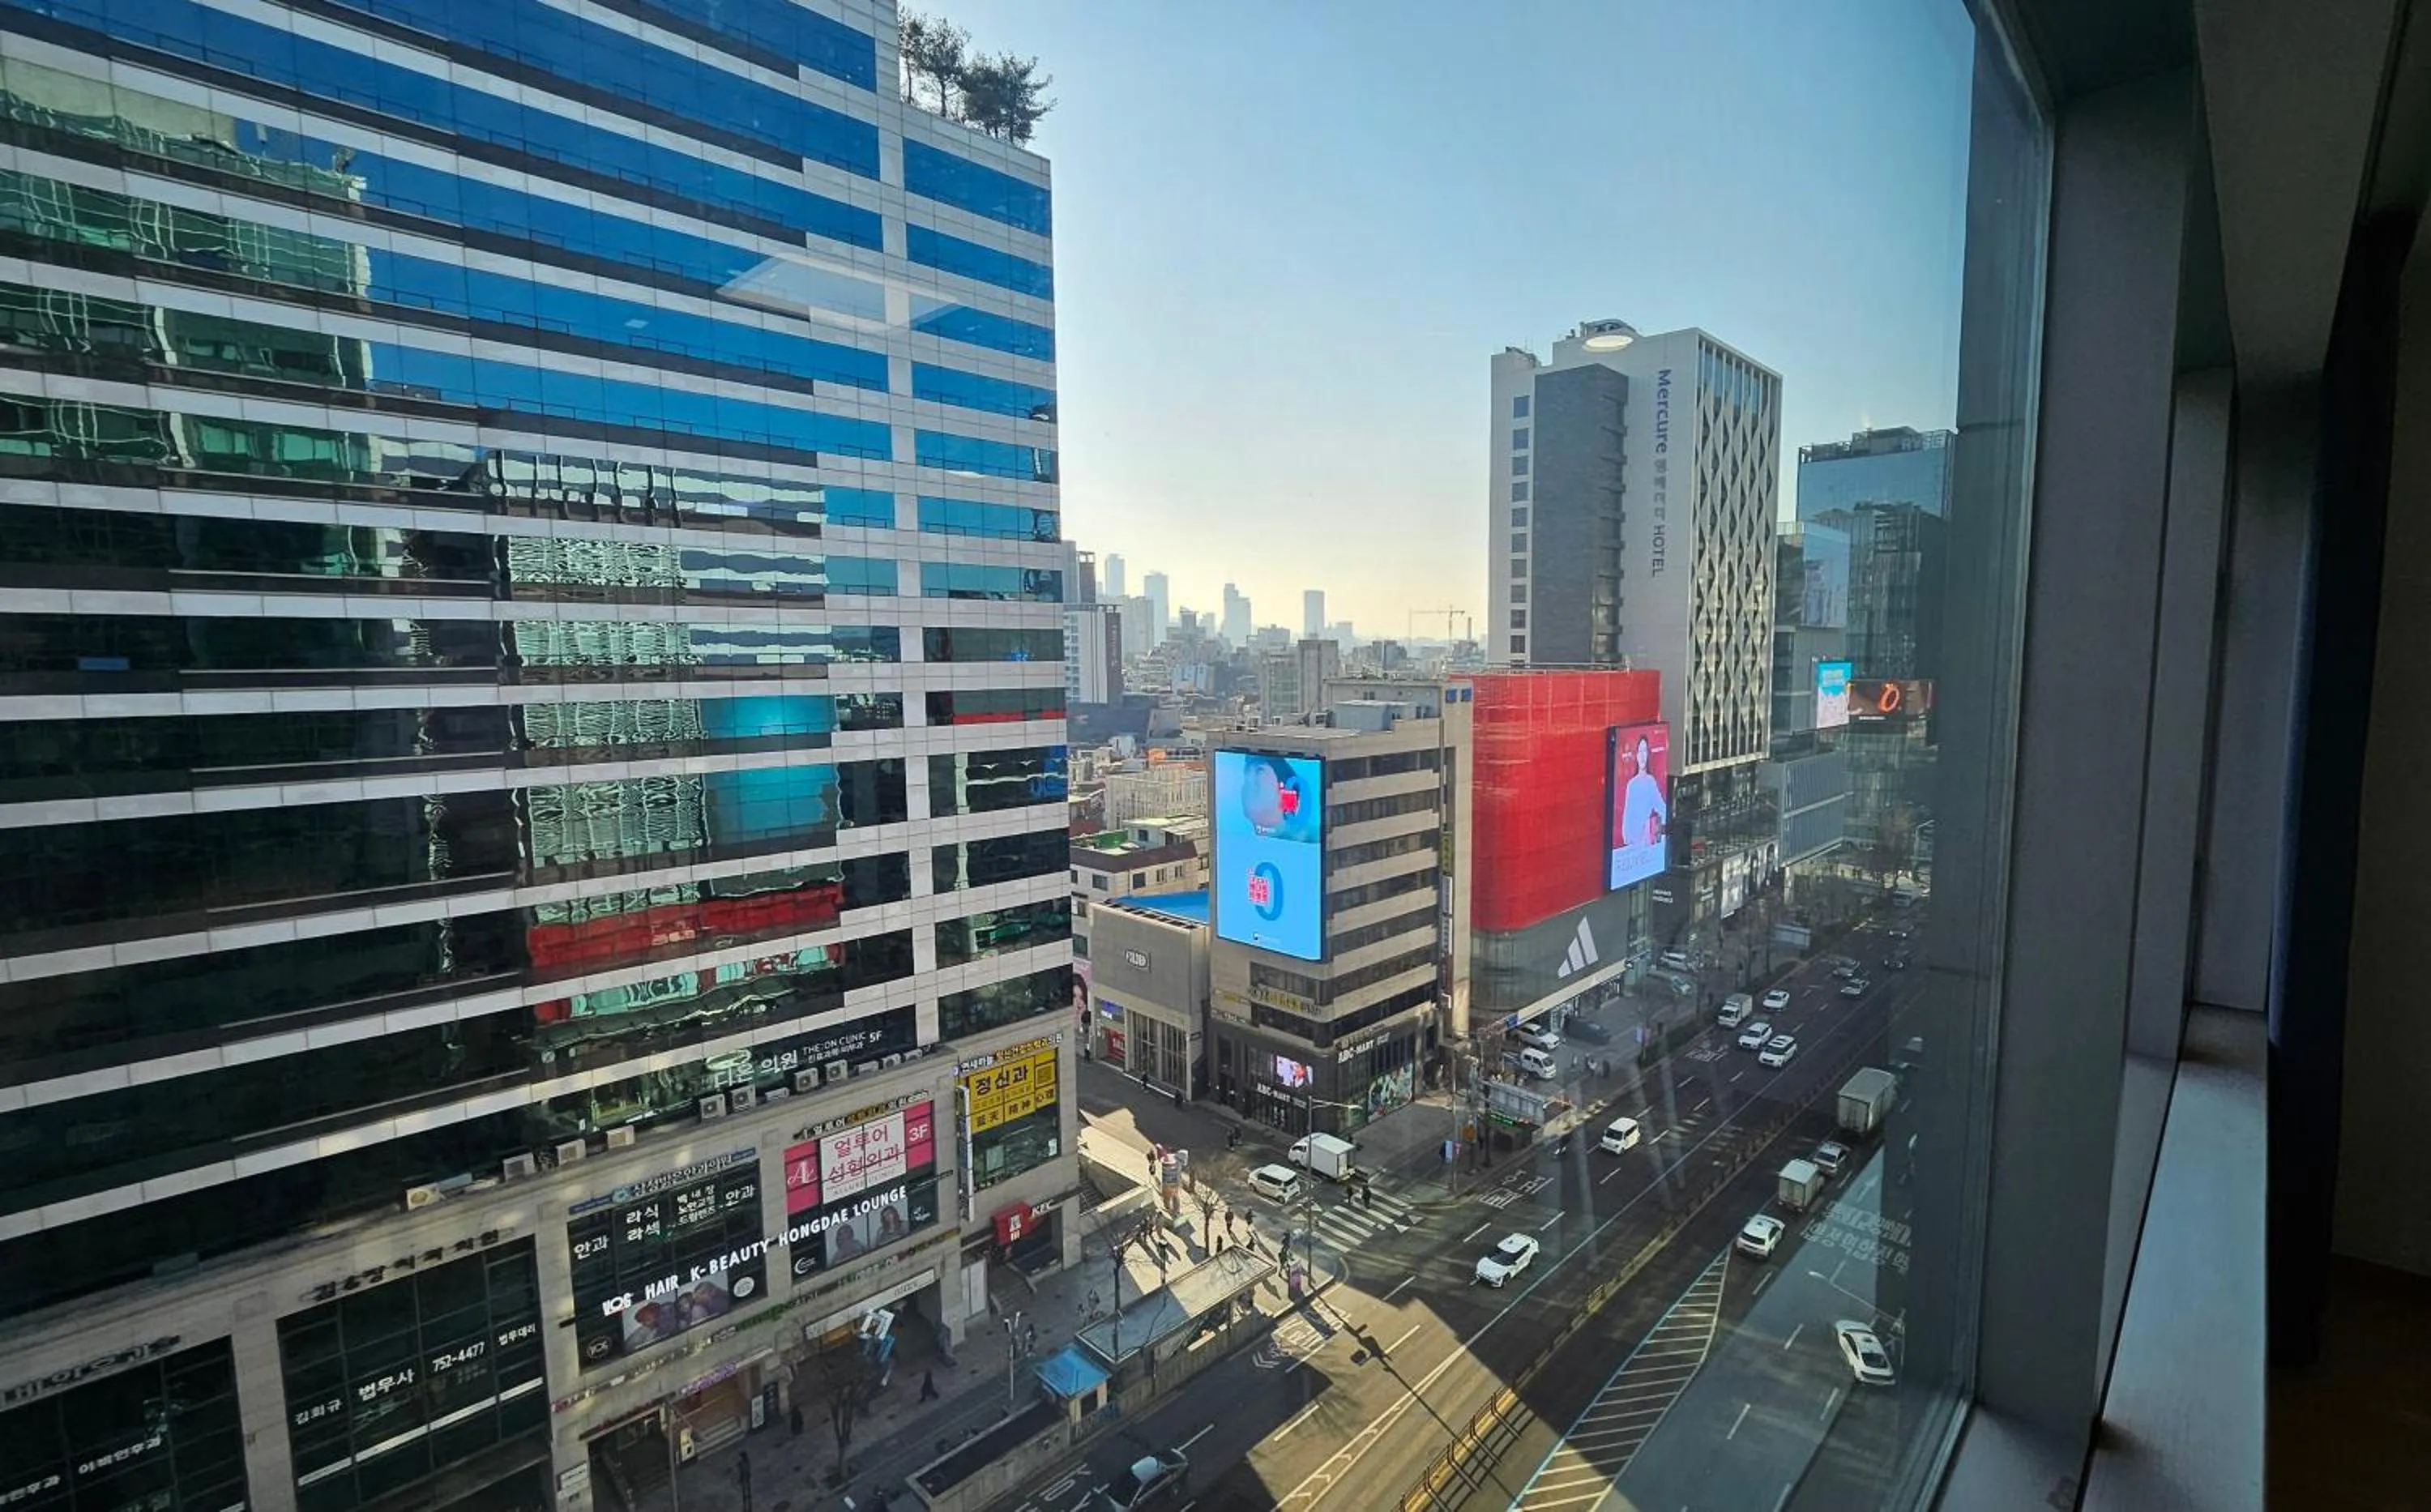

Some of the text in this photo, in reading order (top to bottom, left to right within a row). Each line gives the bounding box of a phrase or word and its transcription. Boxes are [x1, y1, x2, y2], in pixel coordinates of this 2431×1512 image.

[1656, 369, 1672, 453] Mercure
[1652, 525, 1666, 577] HOTEL
[761, 1050, 798, 1074] 의원
[976, 1064, 1028, 1096] 정신과
[908, 1124, 929, 1142] 3F
[829, 1143, 900, 1184] 성형외과
[725, 1184, 755, 1207] 안과
[626, 1203, 659, 1224] 라식
[627, 1220, 660, 1242] 라섹
[645, 1275, 679, 1301] HAIR
[690, 1237, 770, 1281] K-BEAUTY
[779, 1208, 848, 1245] HONGDAE
[854, 1185, 907, 1218] LOUNGE
[574, 1236, 609, 1260] 안과
[359, 1369, 415, 1401] 법무사
